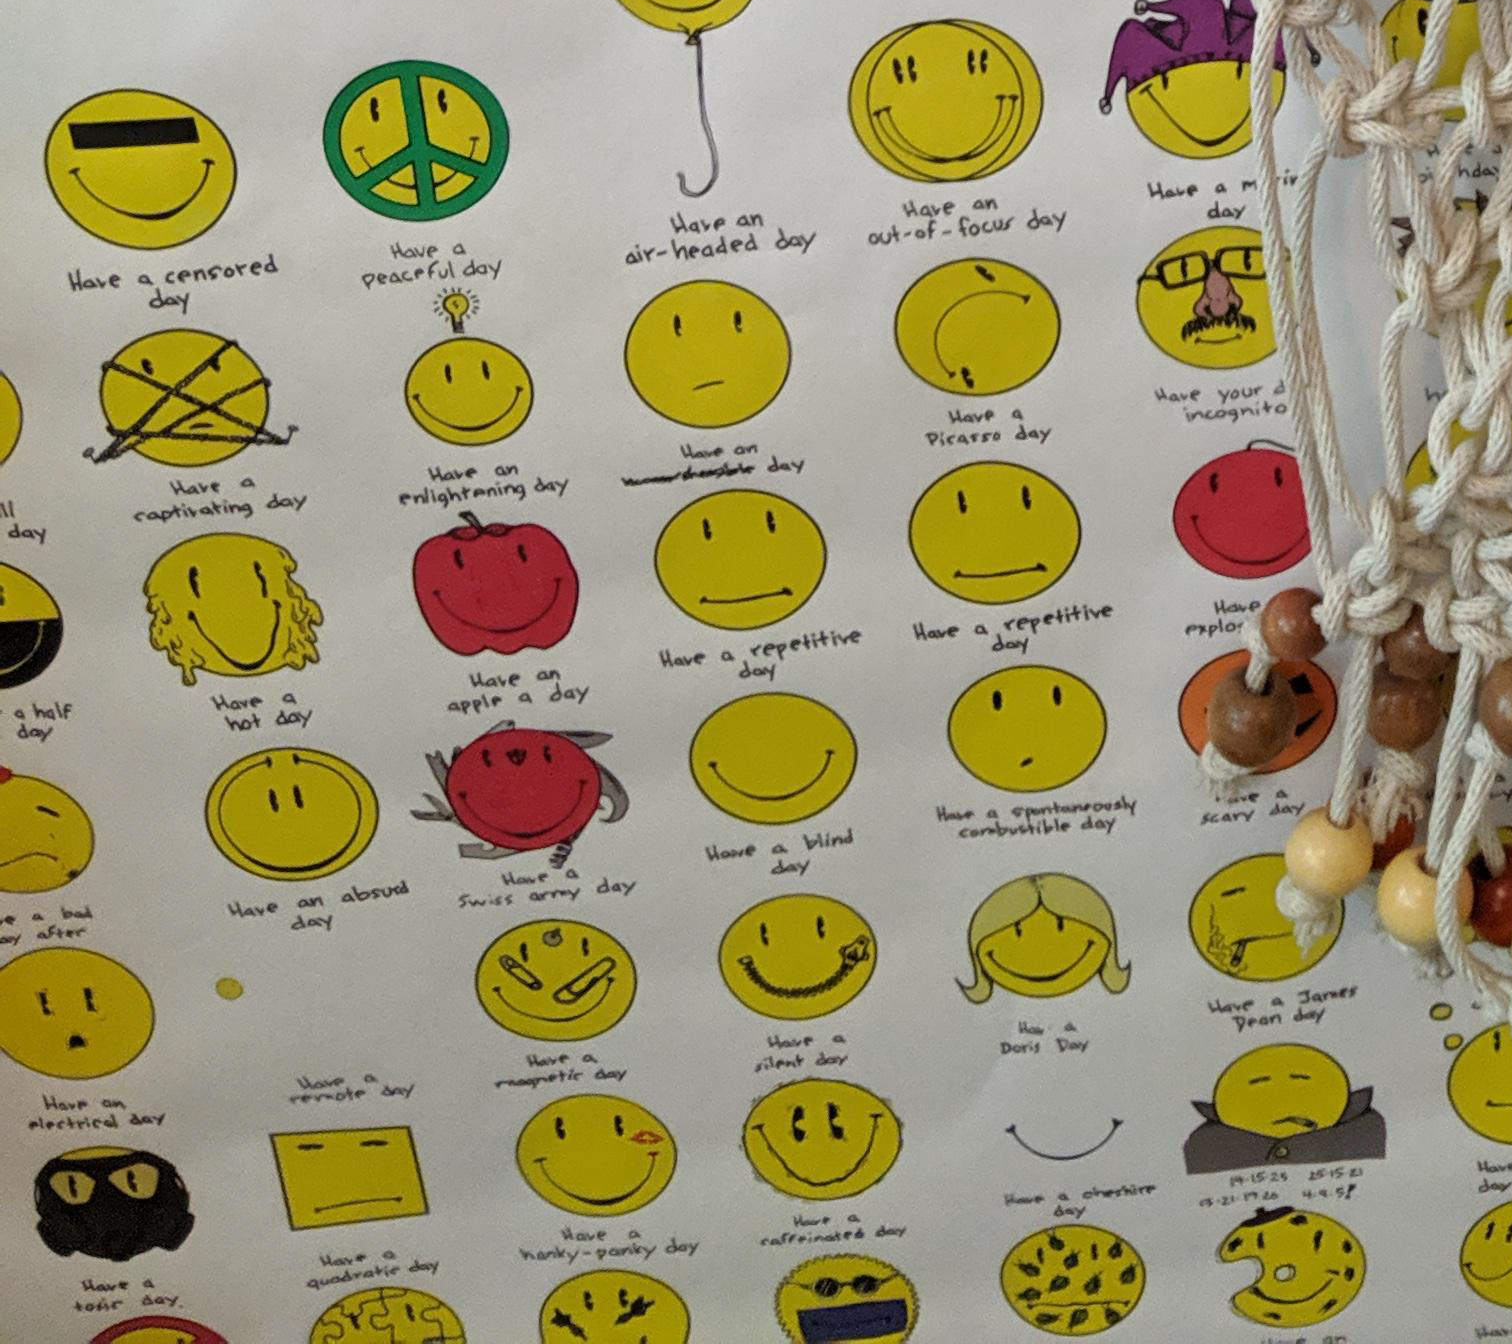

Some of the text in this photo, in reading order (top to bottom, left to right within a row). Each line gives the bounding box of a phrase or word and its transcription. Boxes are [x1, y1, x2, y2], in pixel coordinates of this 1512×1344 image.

[903, 198, 998, 218] Have an
[670, 212, 763, 234] Have an
[868, 209, 1066, 245] out-of-focus day
[390, 243, 466, 259] Have a
[625, 228, 816, 264] air-headed day
[68, 254, 278, 291] Have a censored
[361, 260, 501, 289] peaceful day
[149, 288, 189, 315] day
[948, 409, 1023, 424] Have a
[925, 425, 1051, 446] Picasso day
[428, 465, 518, 482] Have an
[170, 478, 255, 495] Have a
[399, 477, 568, 508] enlightening day
[133, 493, 307, 523] captivating day
[659, 631, 861, 667] Have a repetitive
[469, 670, 560, 687] Have an
[739, 661, 775, 681] day
[211, 693, 297, 710] Have a
[448, 682, 589, 714] apple a day
[225, 710, 312, 731] hot day
[771, 844, 788, 854] a
[803, 828, 853, 850] blind
[771, 860, 810, 876] day
[228, 880, 409, 918] Have an absurd
[291, 915, 333, 931] day
[1208, 986, 1357, 1013] Have a James
[1232, 1007, 1325, 1033] Dean day
[1478, 1178, 1512, 1193] day
